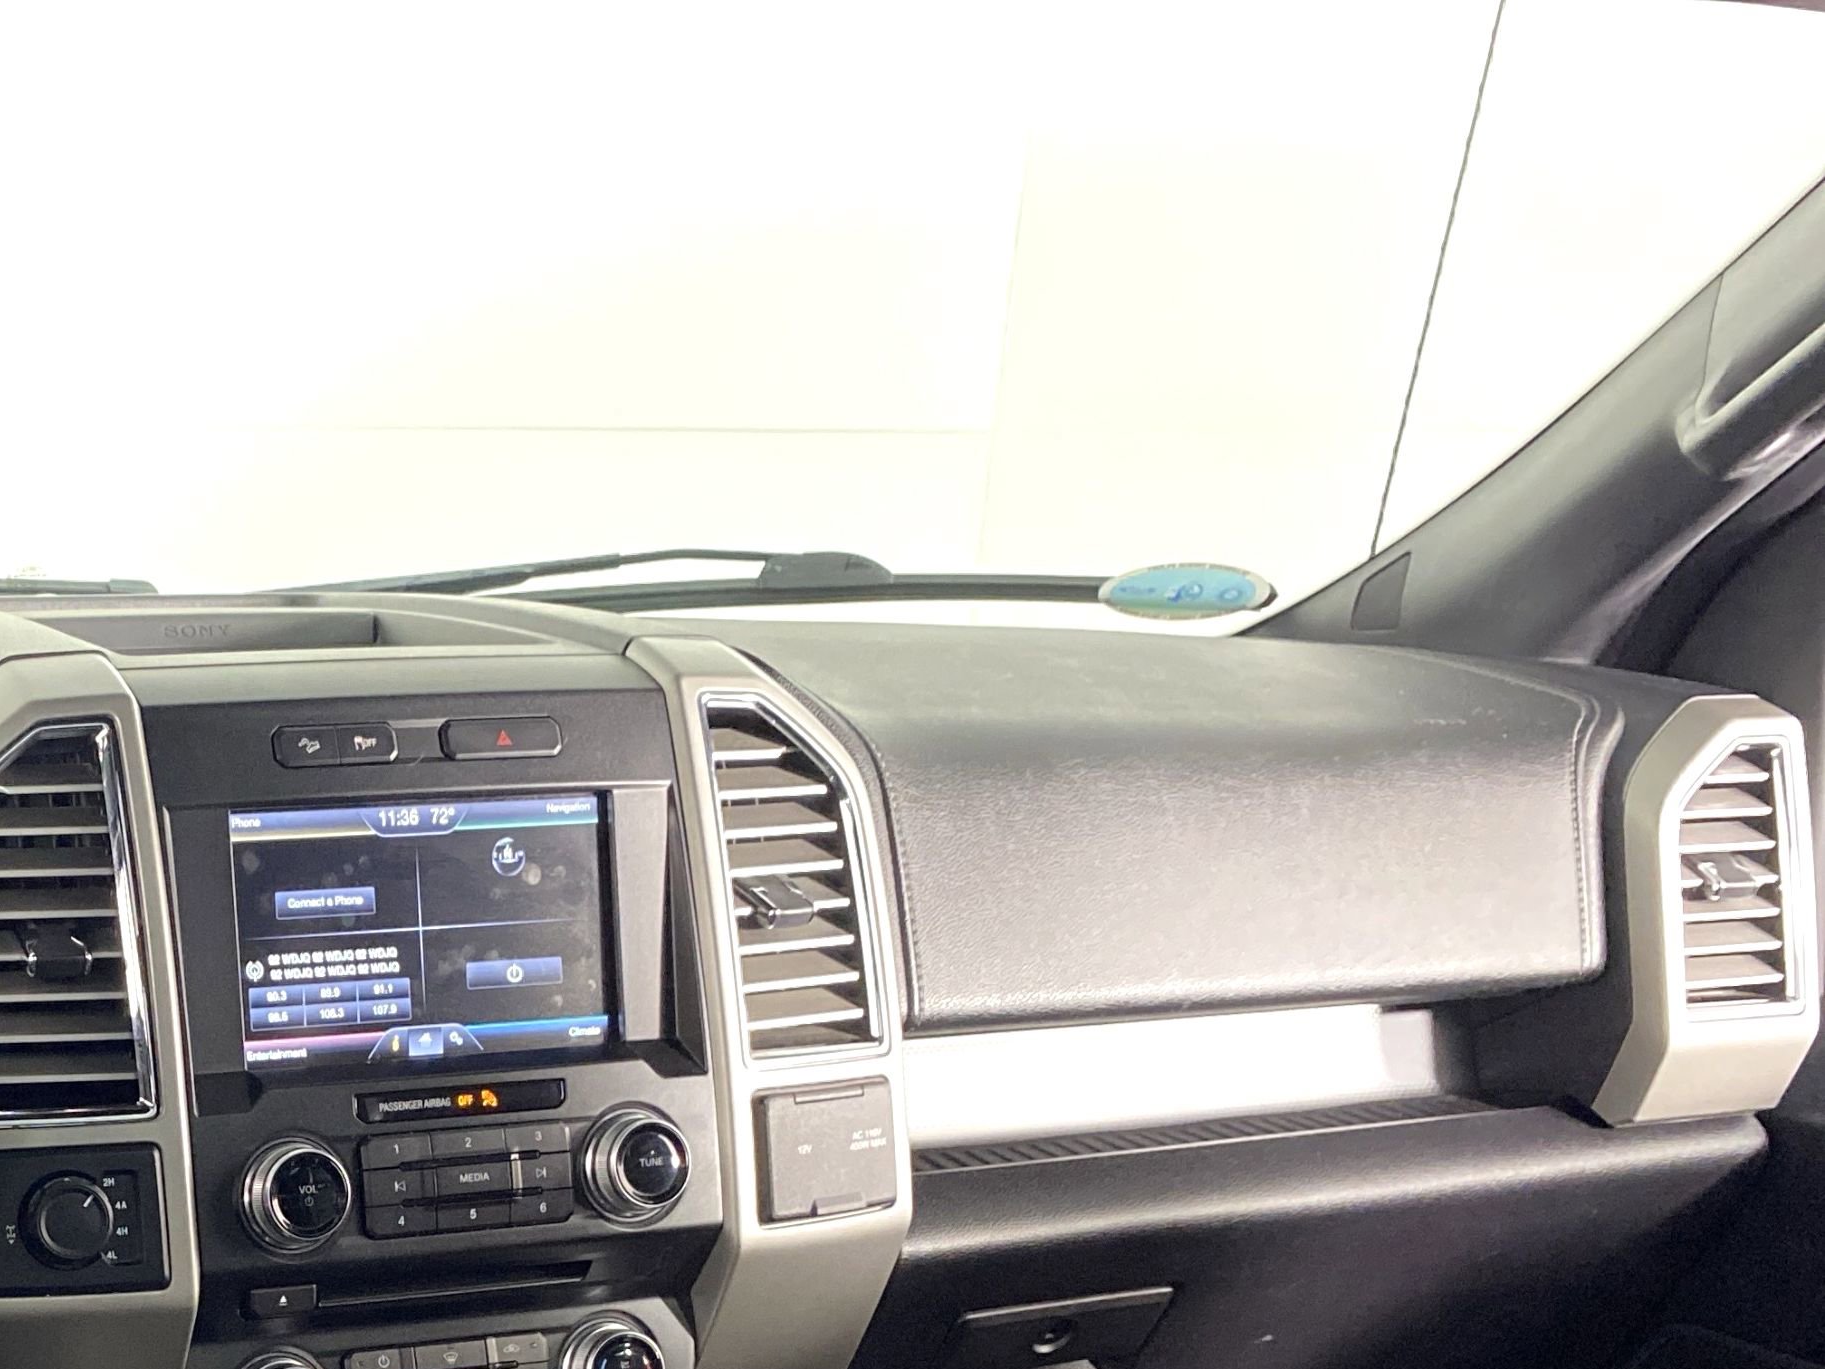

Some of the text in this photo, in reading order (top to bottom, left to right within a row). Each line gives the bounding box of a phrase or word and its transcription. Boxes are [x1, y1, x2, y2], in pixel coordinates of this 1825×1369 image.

[163, 624, 231, 640] SONY
[546, 801, 591, 814] Navigation
[231, 815, 262, 828] Phone
[378, 808, 419, 827] 11:36
[287, 897, 325, 909] Connect
[334, 895, 364, 907] Phone
[569, 1025, 601, 1037] Climate
[246, 1048, 308, 1062] Entertainment
[379, 1093, 474, 1112] PASSENGER AIRBAG OFF
[535, 1131, 542, 1141] 3
[464, 1138, 472, 1148] 2
[393, 1144, 400, 1154] 1
[639, 1156, 664, 1167] TUNE
[102, 1177, 115, 1187] 2H
[459, 1172, 490, 1183] MEDIA
[298, 1185, 318, 1194] VOL
[115, 1200, 127, 1209] 4A
[539, 1202, 547, 1212] 6
[469, 1209, 477, 1219] 5
[398, 1216, 405, 1226] 4
[116, 1226, 128, 1235] 4H
